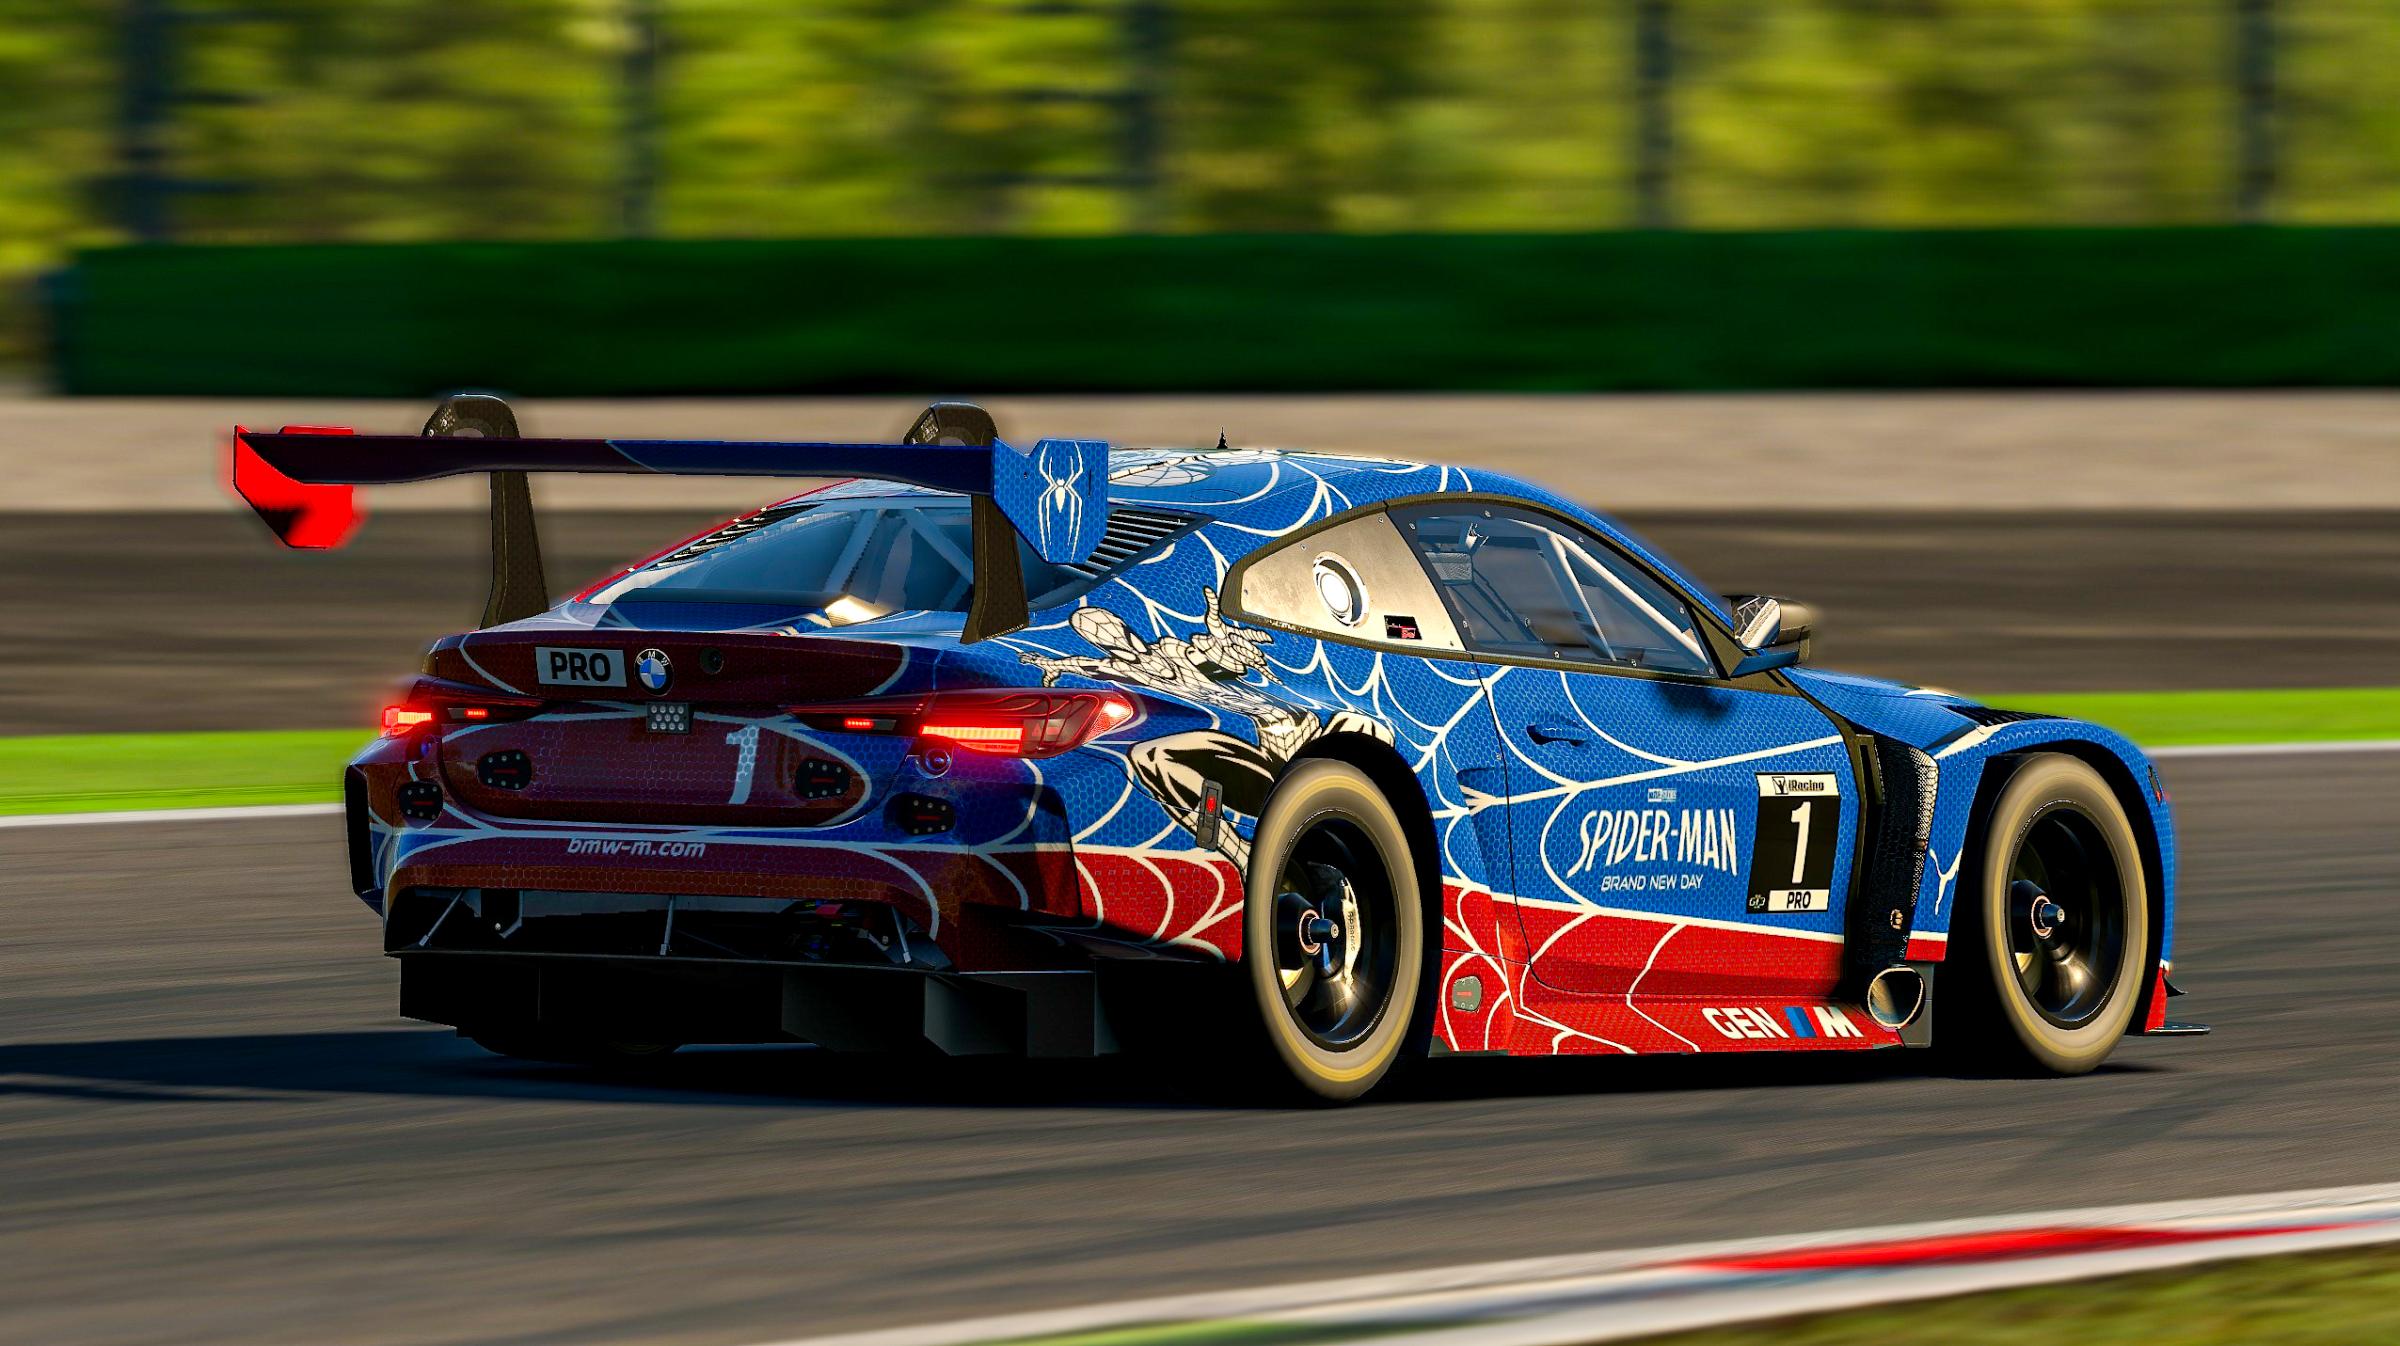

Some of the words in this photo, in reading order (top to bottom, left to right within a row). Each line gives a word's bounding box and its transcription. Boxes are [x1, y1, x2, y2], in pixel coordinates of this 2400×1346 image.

[550, 651, 611, 682] PRO
[636, 650, 670, 666] BMW
[726, 725, 760, 805] 1
[1788, 779, 1825, 792] iRacing
[567, 838, 706, 857] bmw-m.com
[1566, 808, 1738, 879] SPIDER-MAN
[1791, 801, 1811, 884] 1
[1601, 875, 1647, 892] BRAND
[1650, 874, 1677, 890] NEW
[1680, 874, 1704, 890] DAY
[1786, 891, 1812, 909] PRO
[1701, 1007, 1790, 1040] GEN
[1812, 1006, 1865, 1038] M
